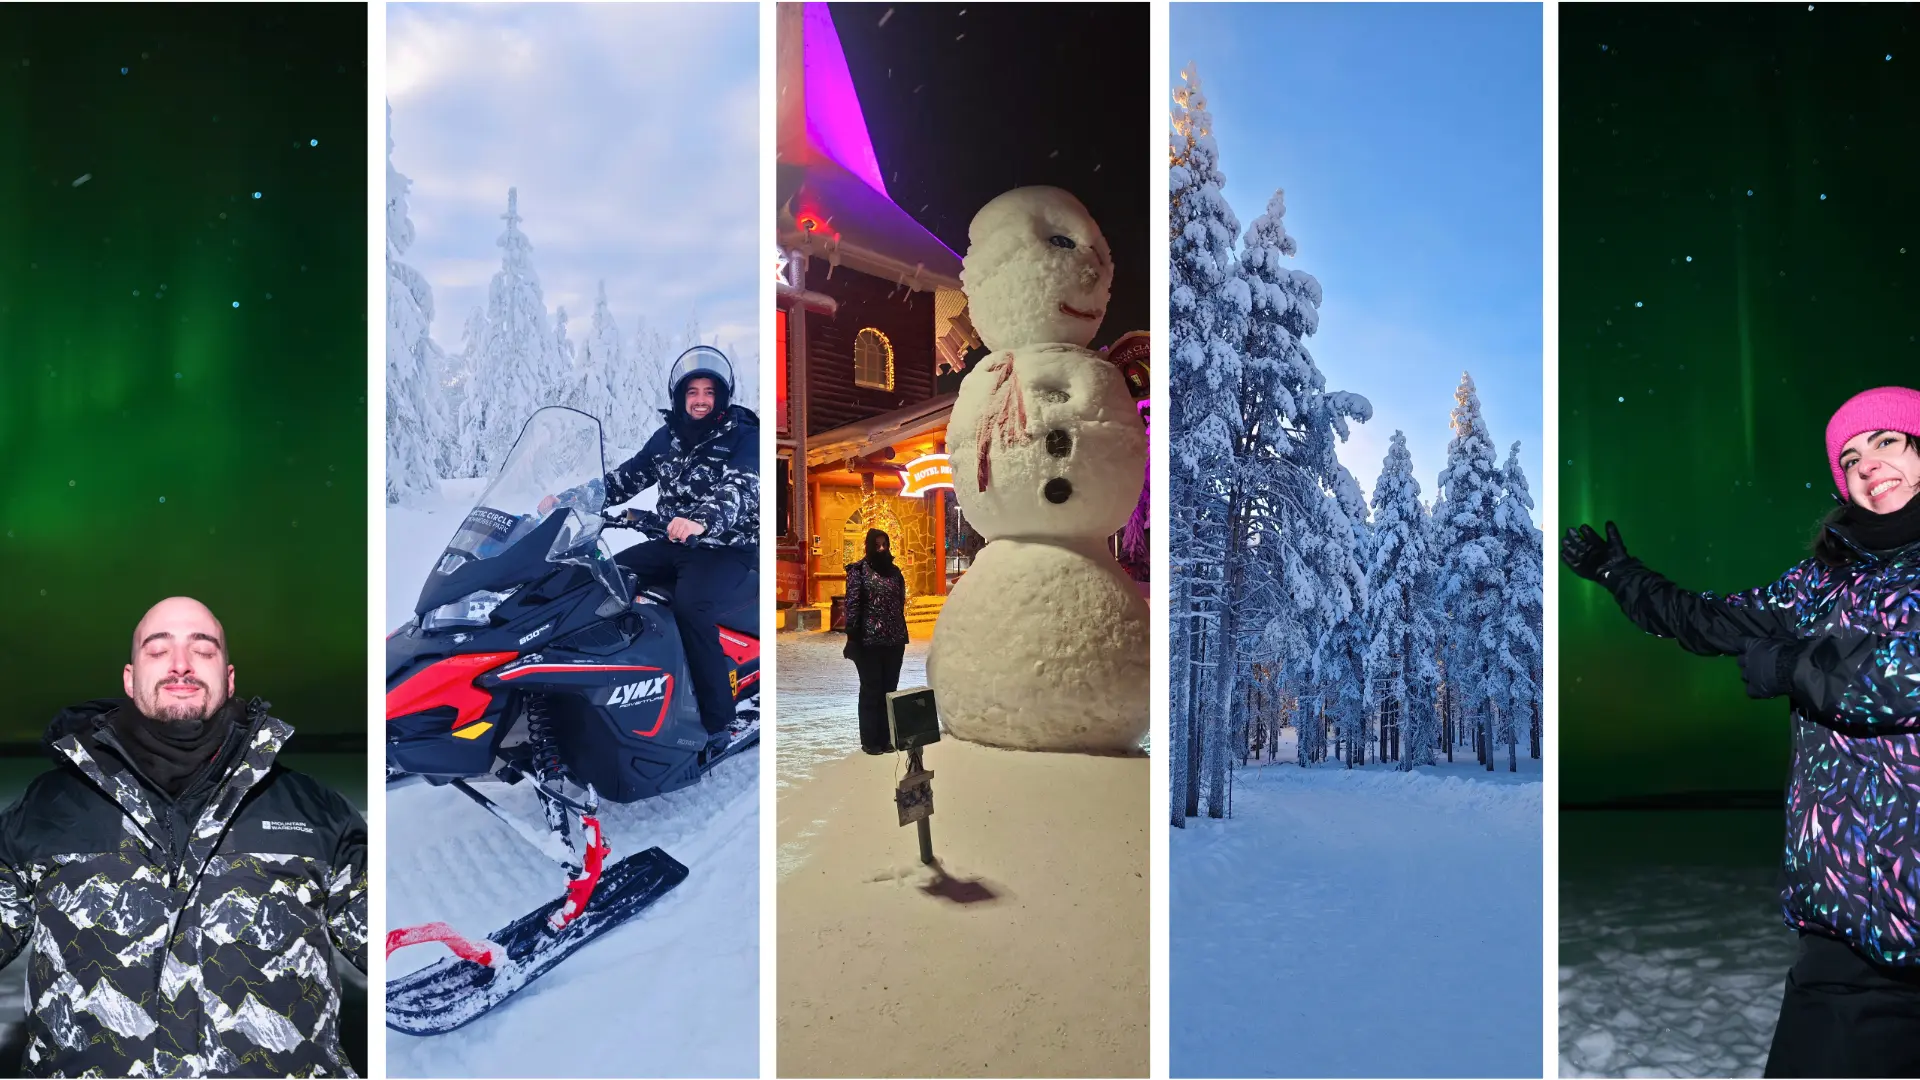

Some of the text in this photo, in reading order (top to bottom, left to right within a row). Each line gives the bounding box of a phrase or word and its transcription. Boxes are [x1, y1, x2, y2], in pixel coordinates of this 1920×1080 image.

[1133, 344, 1150, 352] CLA
[914, 466, 939, 482] HOTEL
[487, 512, 513, 527] CIRCLE
[492, 522, 509, 534] PARK
[606, 675, 670, 705] LYNX
